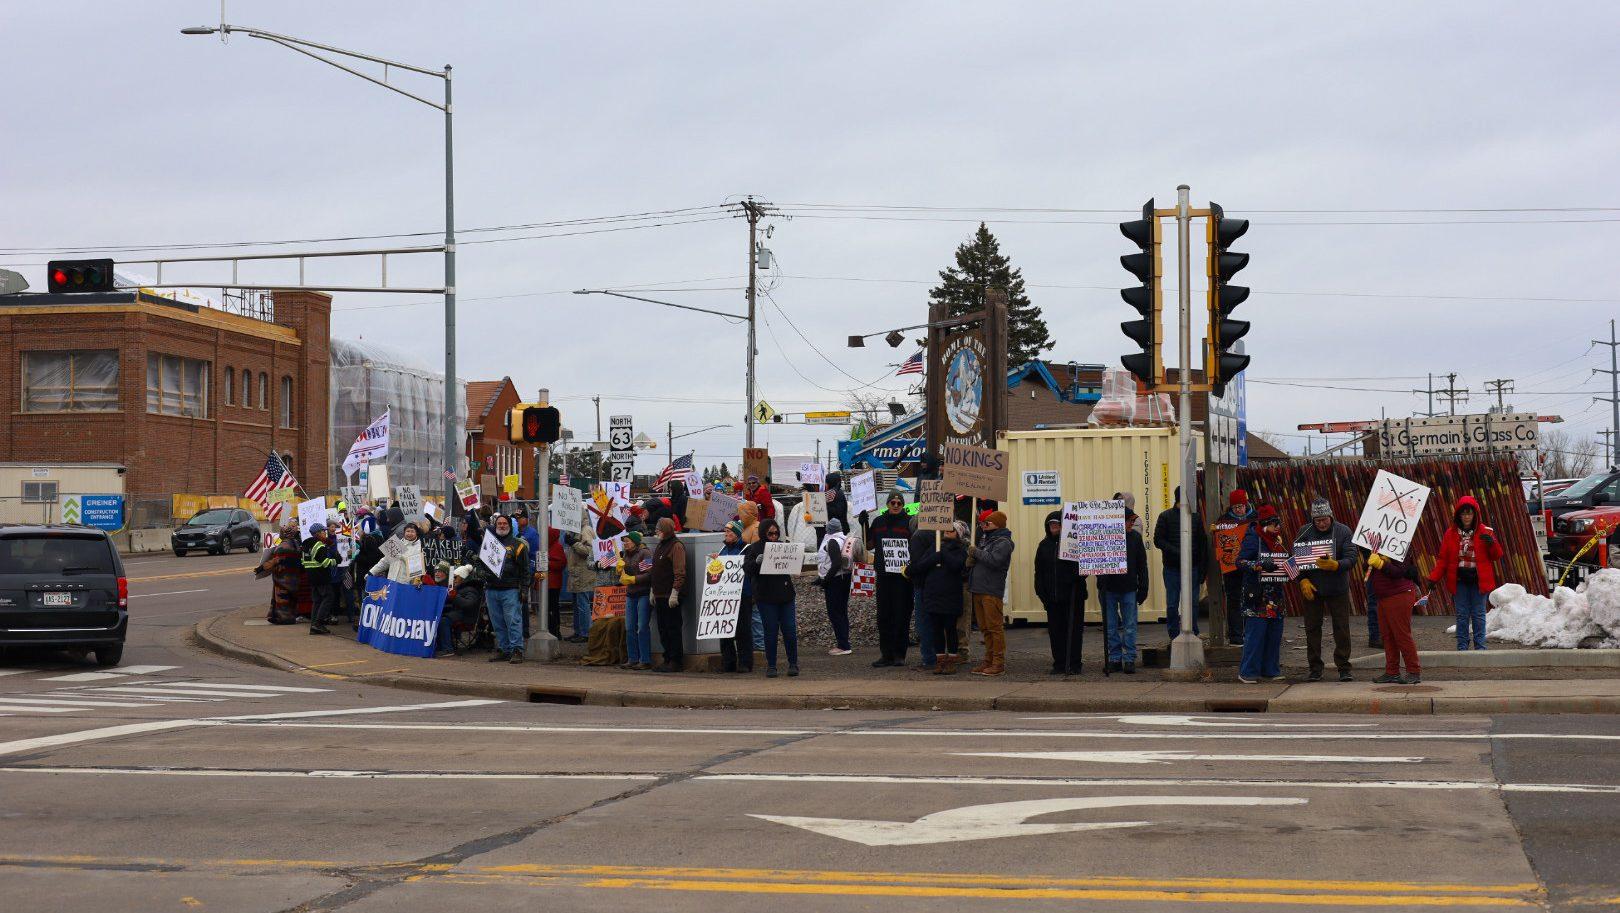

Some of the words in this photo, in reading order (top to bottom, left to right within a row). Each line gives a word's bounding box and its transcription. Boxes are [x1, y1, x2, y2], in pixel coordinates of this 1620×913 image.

[611, 418, 632, 426] NORTH
[612, 432, 631, 445] 63
[1398, 429, 1471, 447] Germain's
[1515, 424, 1537, 441] Co.
[612, 453, 633, 461] NORTH
[746, 450, 763, 460] NO
[946, 447, 961, 465] NO
[962, 449, 1003, 471] KINGS
[613, 467, 632, 480] 27
[920, 481, 931, 491] ALL
[402, 500, 418, 508] KING
[920, 492, 954, 504] OUTRAGE
[1379, 513, 1407, 534] NO
[423, 537, 449, 549] WAKE
[452, 540, 463, 549] UP
[1293, 539, 1334, 547] PRO-AMERICA
[422, 548, 453, 558] STAND
[453, 550, 463, 559] UP
[898, 550, 908, 558] ON
[726, 571, 744, 584] YOU
[701, 599, 740, 616] FASCIST
[698, 619, 735, 637] LIARS
